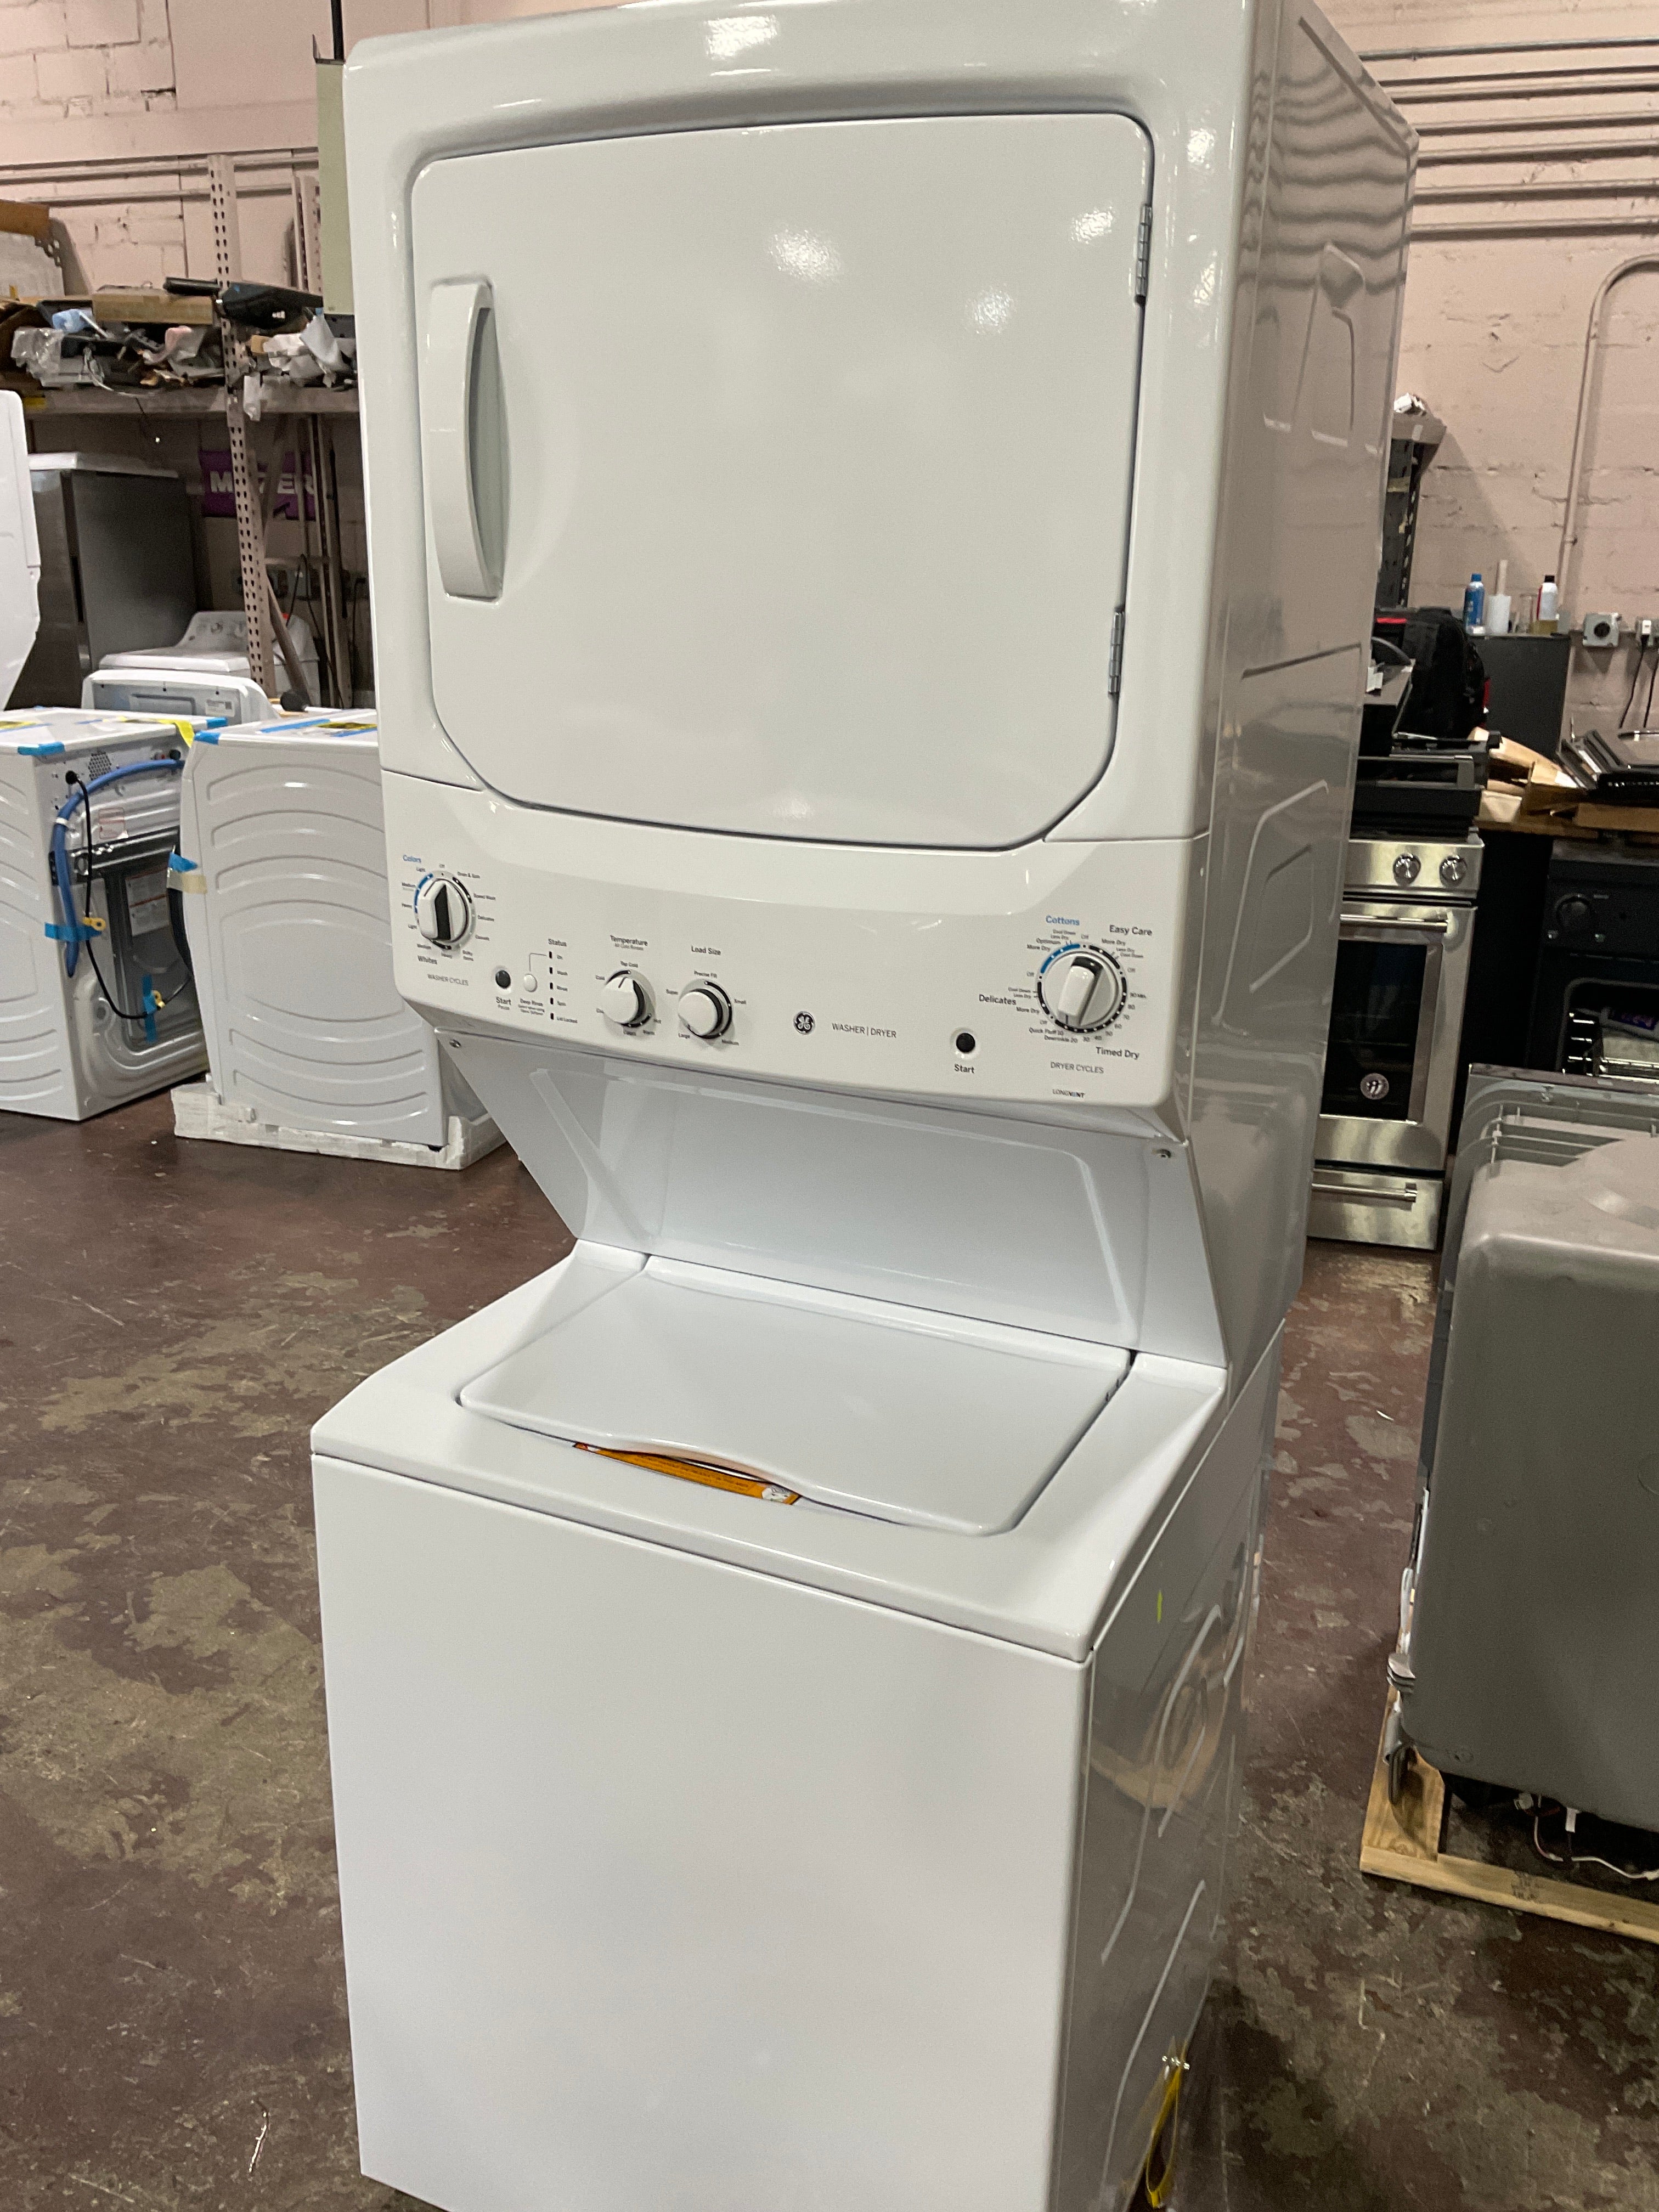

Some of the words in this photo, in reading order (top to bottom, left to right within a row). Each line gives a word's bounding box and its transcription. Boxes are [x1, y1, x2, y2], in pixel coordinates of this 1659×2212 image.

[1045, 915, 1080, 926] Cottons
[1109, 924, 1130, 935] Easy
[1132, 926, 1152, 936] Care
[548, 938, 567, 947] Status
[610, 935, 648, 946] Temperature
[691, 945, 706, 953] Load
[708, 947, 721, 956] Size
[496, 996, 511, 1005] Start
[979, 994, 1017, 1005] Delicates
[1096, 1047, 1122, 1057] Timed
[1125, 1049, 1139, 1060] Dry
[954, 1064, 974, 1074] Start
[1051, 1062, 1074, 1070] DRYER
[1076, 1064, 1104, 1074] CYCLES
